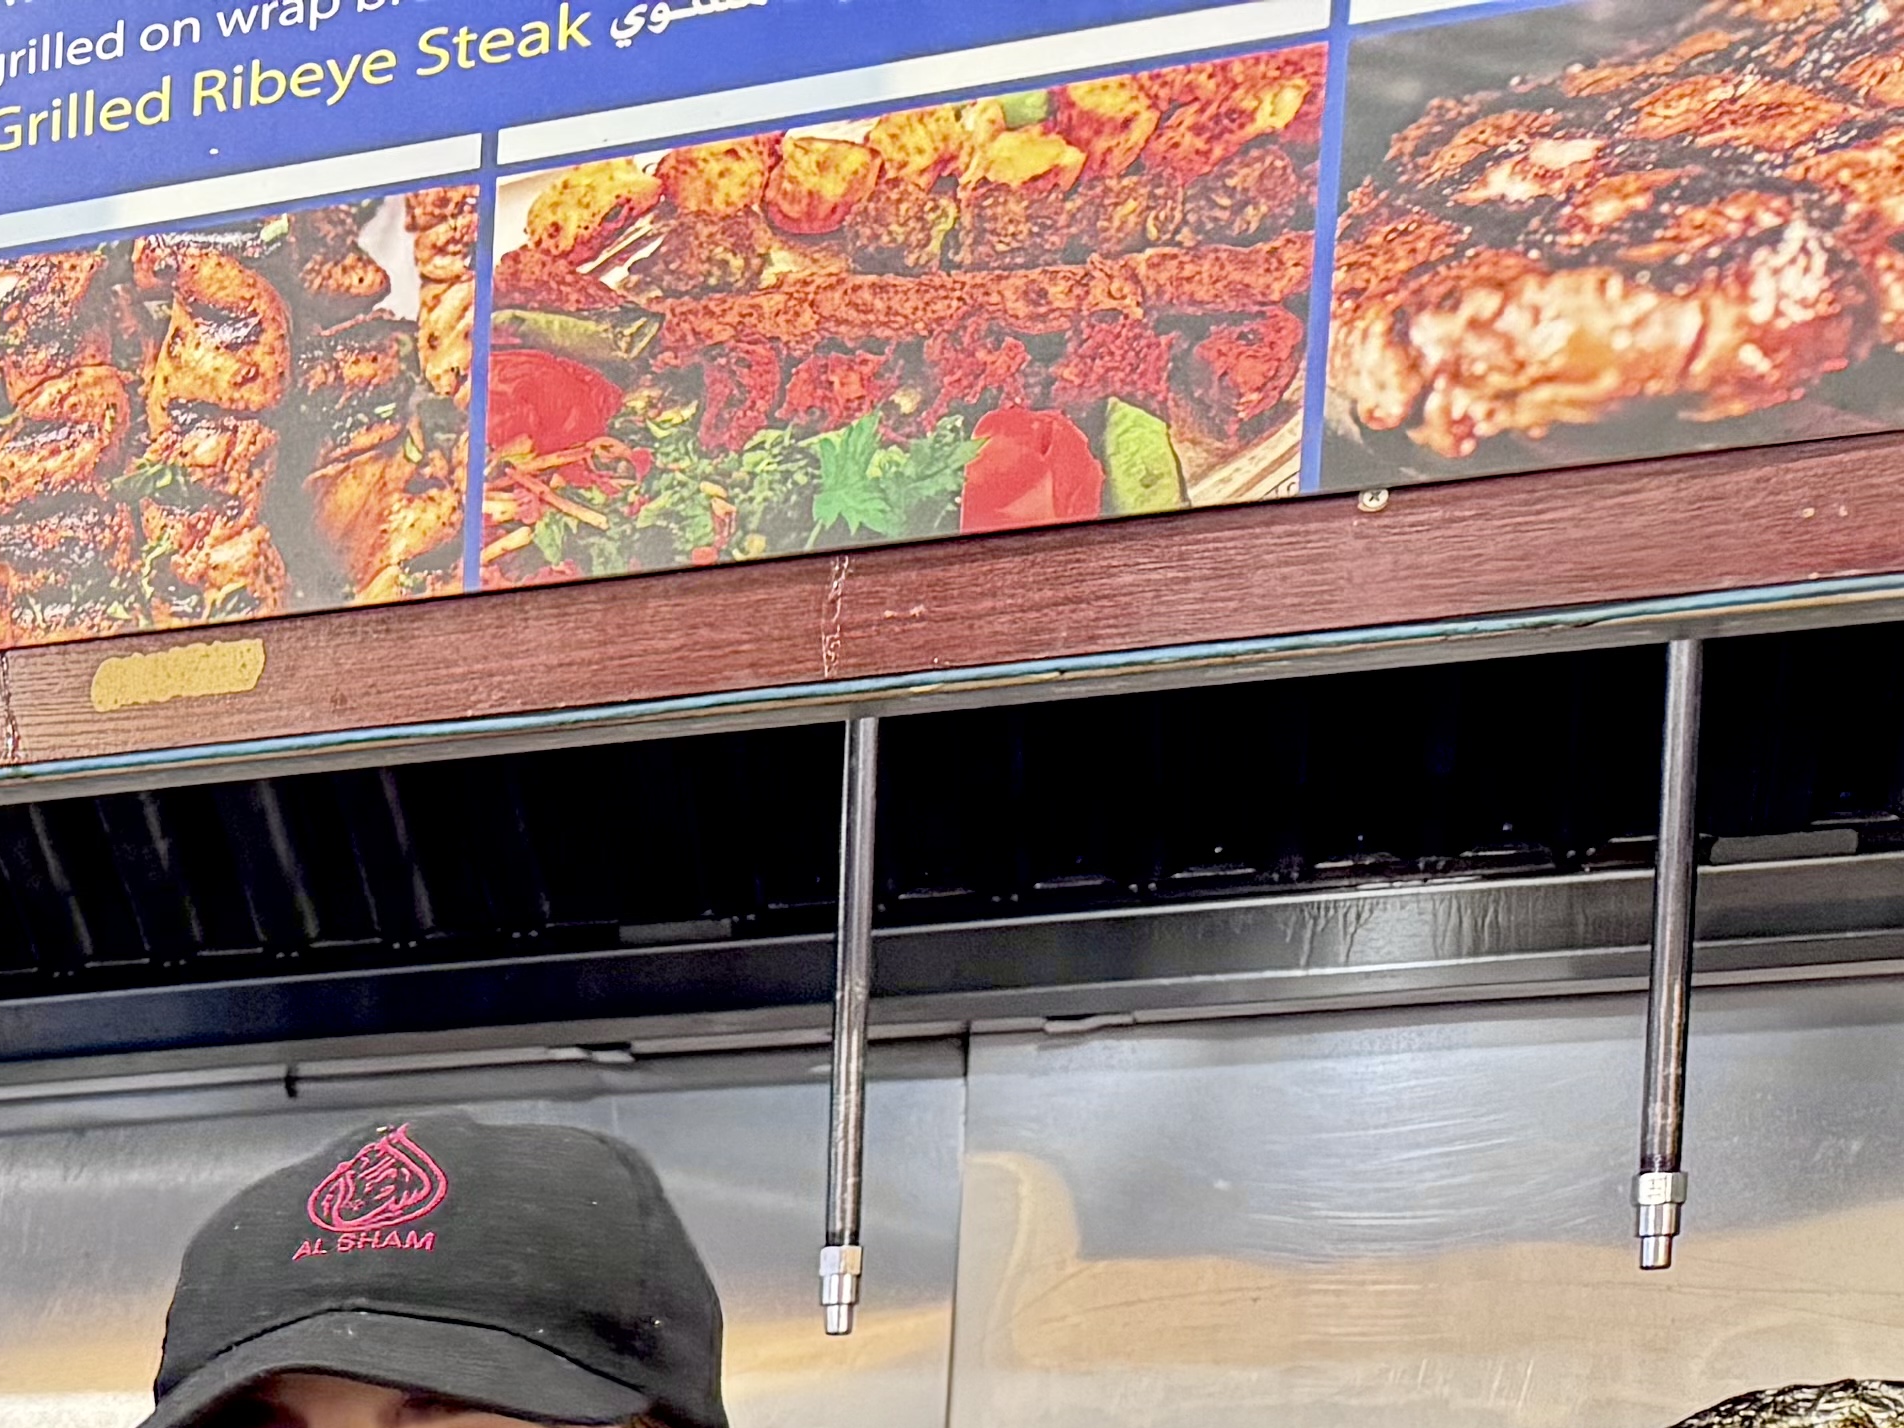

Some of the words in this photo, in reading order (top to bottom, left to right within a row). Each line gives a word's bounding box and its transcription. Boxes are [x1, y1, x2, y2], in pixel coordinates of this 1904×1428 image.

[140, 17, 201, 51] on
[217, 0, 341, 37] wrap
[193, 49, 396, 116] Ribeye
[417, 3, 591, 75] Steak
[292, 1238, 328, 1261] AL
[337, 1230, 436, 1252] SHAM
